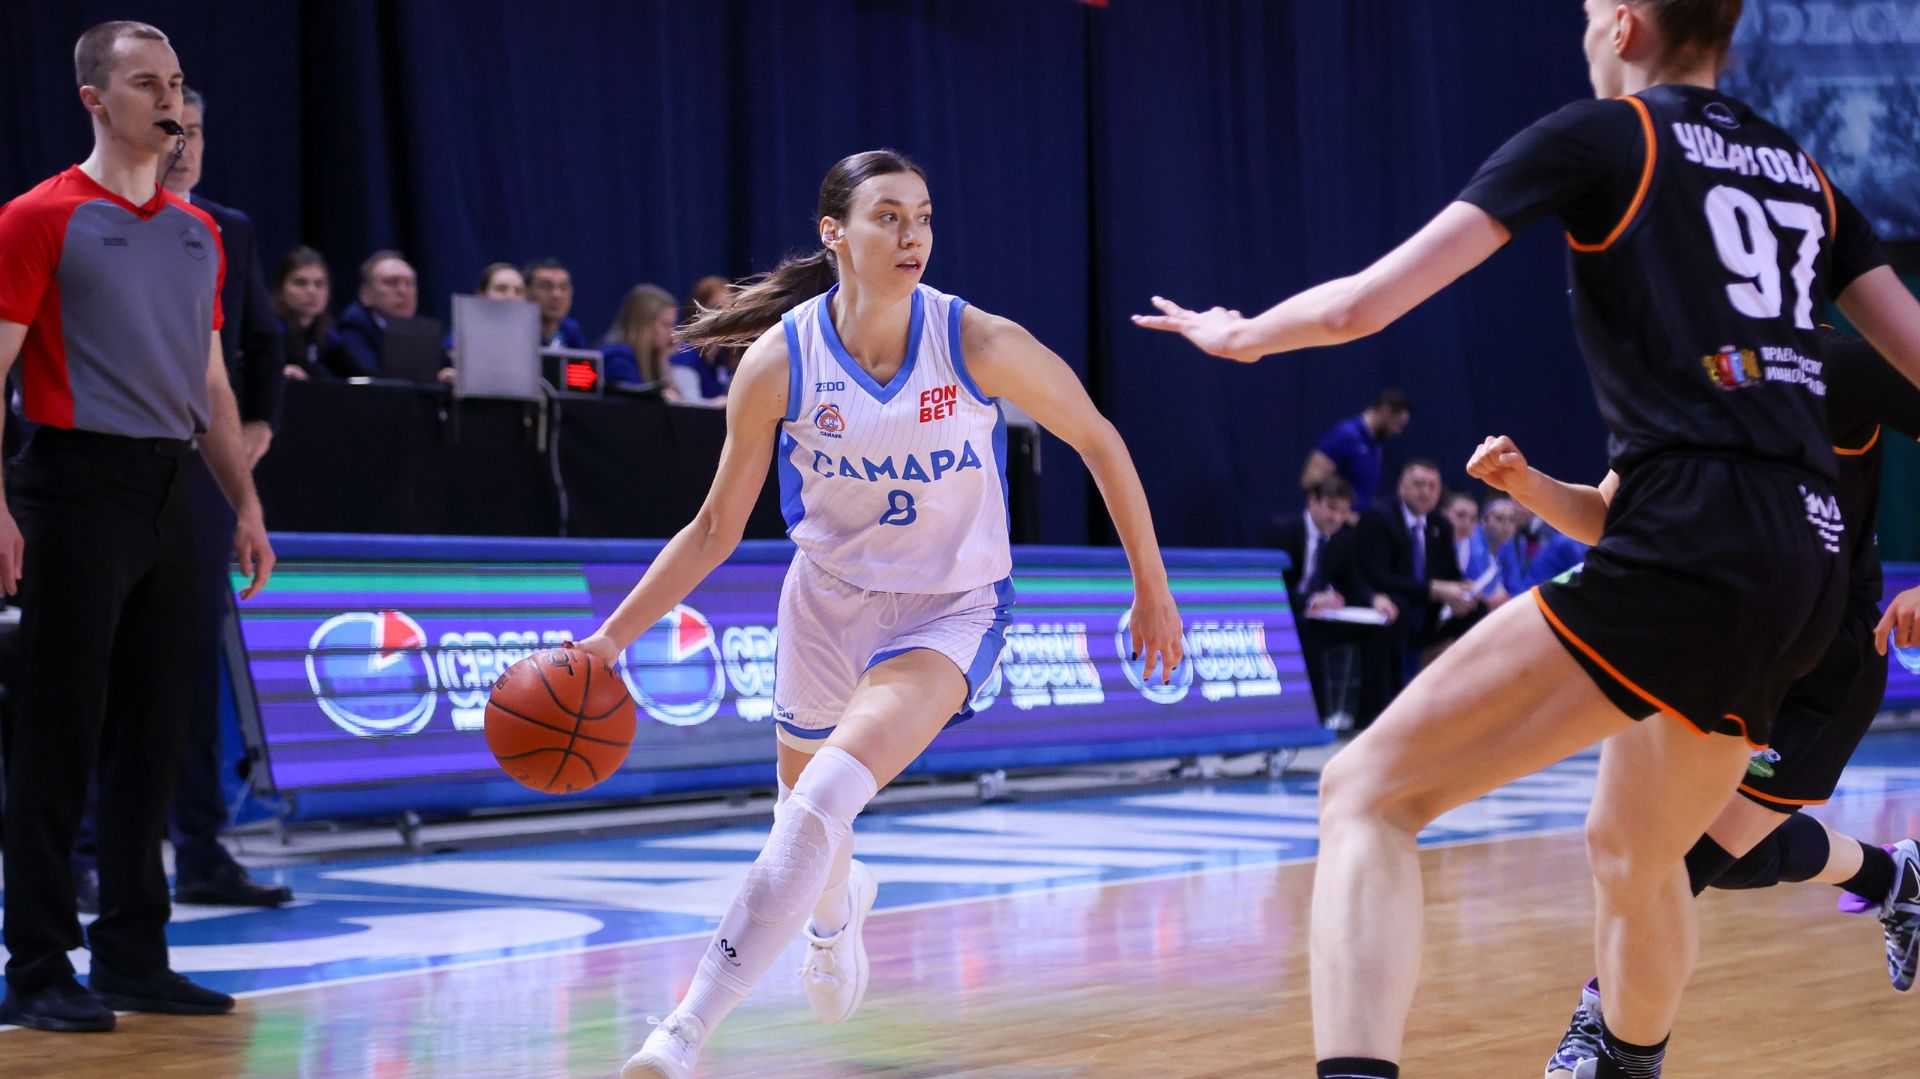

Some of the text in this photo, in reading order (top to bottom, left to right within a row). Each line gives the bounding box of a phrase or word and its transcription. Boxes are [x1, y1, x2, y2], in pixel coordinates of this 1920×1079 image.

[1704, 185, 1825, 330] 97
[815, 381, 845, 392] ZEDO
[920, 385, 957, 407] FON
[919, 400, 957, 423] BET
[813, 439, 983, 484] САМАРА
[879, 489, 917, 526] 8
